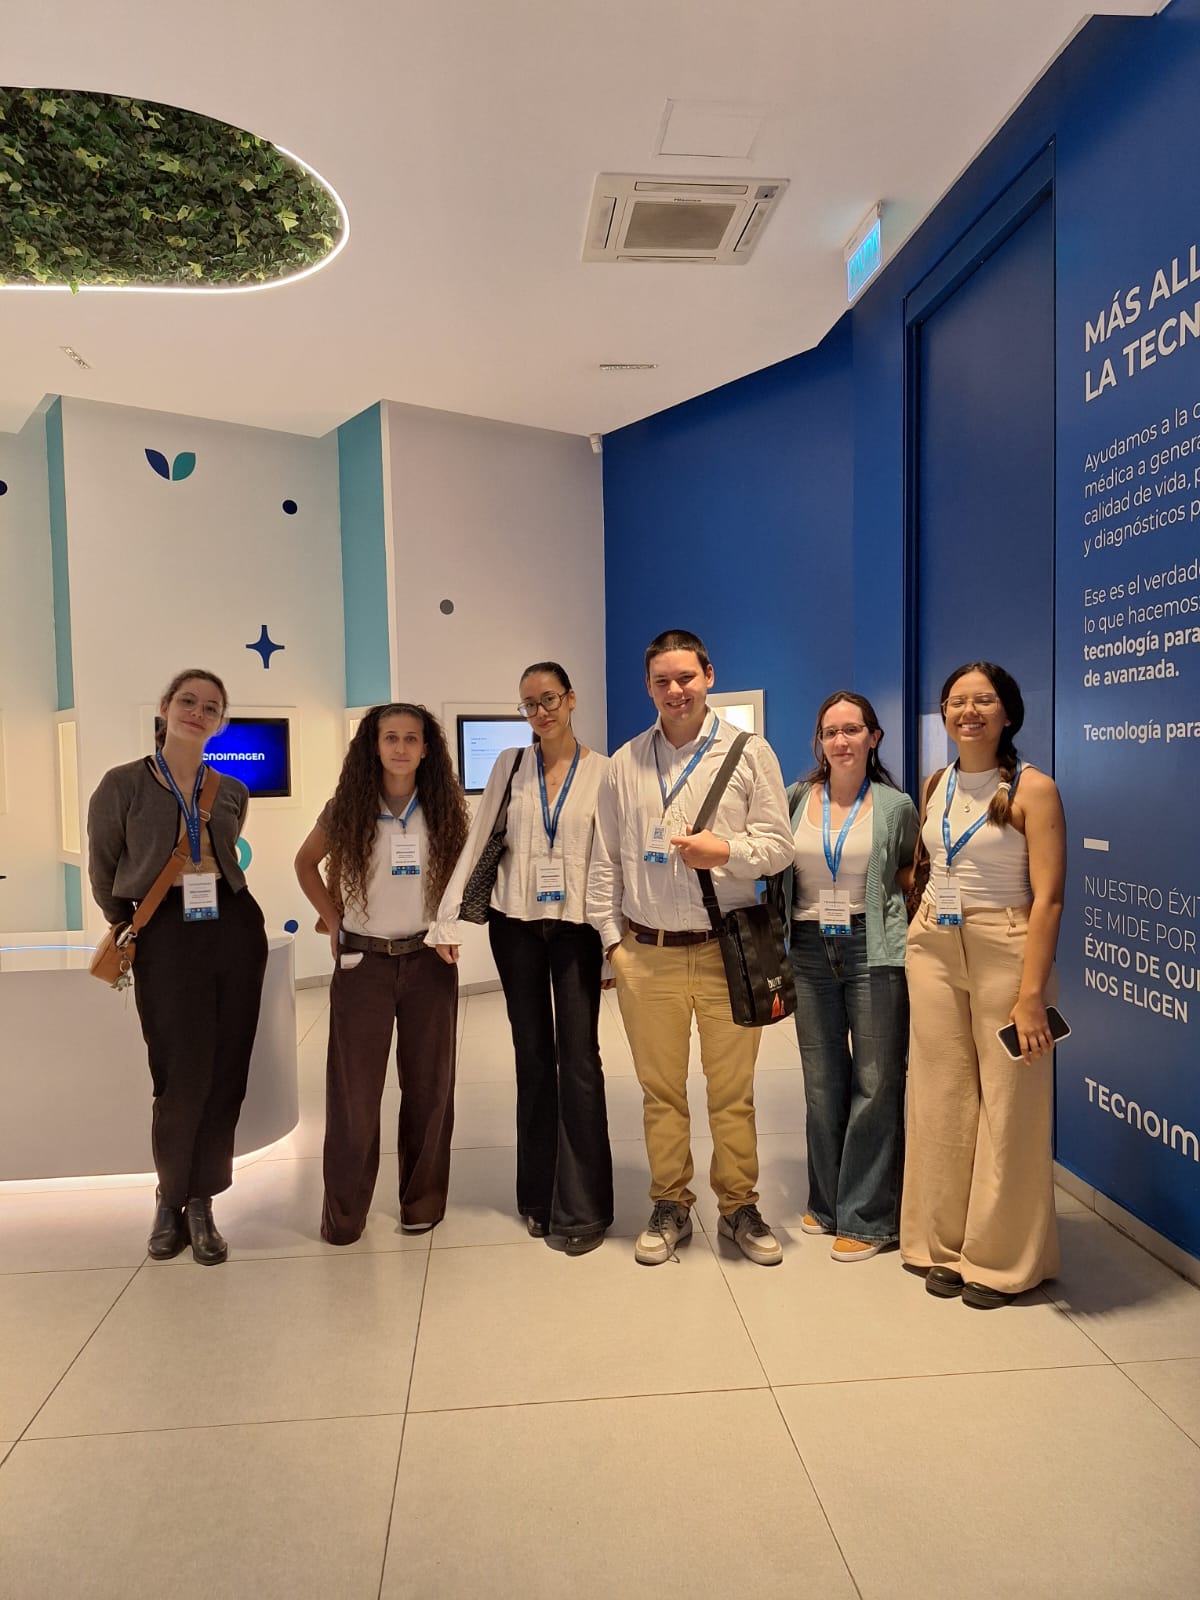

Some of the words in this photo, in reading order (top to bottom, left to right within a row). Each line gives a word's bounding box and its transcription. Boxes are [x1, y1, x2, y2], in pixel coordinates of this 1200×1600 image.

[1085, 290, 1141, 352] MÁS
[1149, 245, 1200, 310] ALL
[1086, 358, 1117, 402] LA
[1122, 301, 1200, 376] TECN
[1084, 424, 1158, 472] Ayudamos
[1161, 418, 1170, 435] a
[1175, 408, 1188, 429] la
[1084, 466, 1134, 498] médica
[1137, 460, 1146, 475] a
[1084, 490, 1130, 526] calidad
[1133, 485, 1151, 506] de
[1155, 471, 1191, 498] vida,
[1083, 538, 1092, 558] y
[1094, 504, 1186, 550] diagnósticos
[1084, 588, 1106, 607] Ese
[1109, 583, 1125, 600] es
[1128, 574, 1140, 596] el
[1144, 558, 1200, 591] verdad
[1083, 630, 1159, 661] tecnología
[1084, 616, 1095, 634] lo
[1098, 612, 1124, 635] que
[1084, 668, 1101, 688] de
[1104, 658, 1179, 686] avanzada.
[1083, 719, 1161, 744] Tecnología
[202, 752, 265, 761] CNOIMAGEN
[1084, 875, 1163, 910] NUESTRO
[1084, 906, 1103, 929] SE
[1107, 911, 1150, 942] MIDE
[1156, 923, 1196, 954] POR
[1084, 932, 1131, 968] ÉXITO
[1136, 951, 1160, 979] DE
[1085, 967, 1119, 997] NOS
[1123, 980, 1188, 1023] ELIGEN
